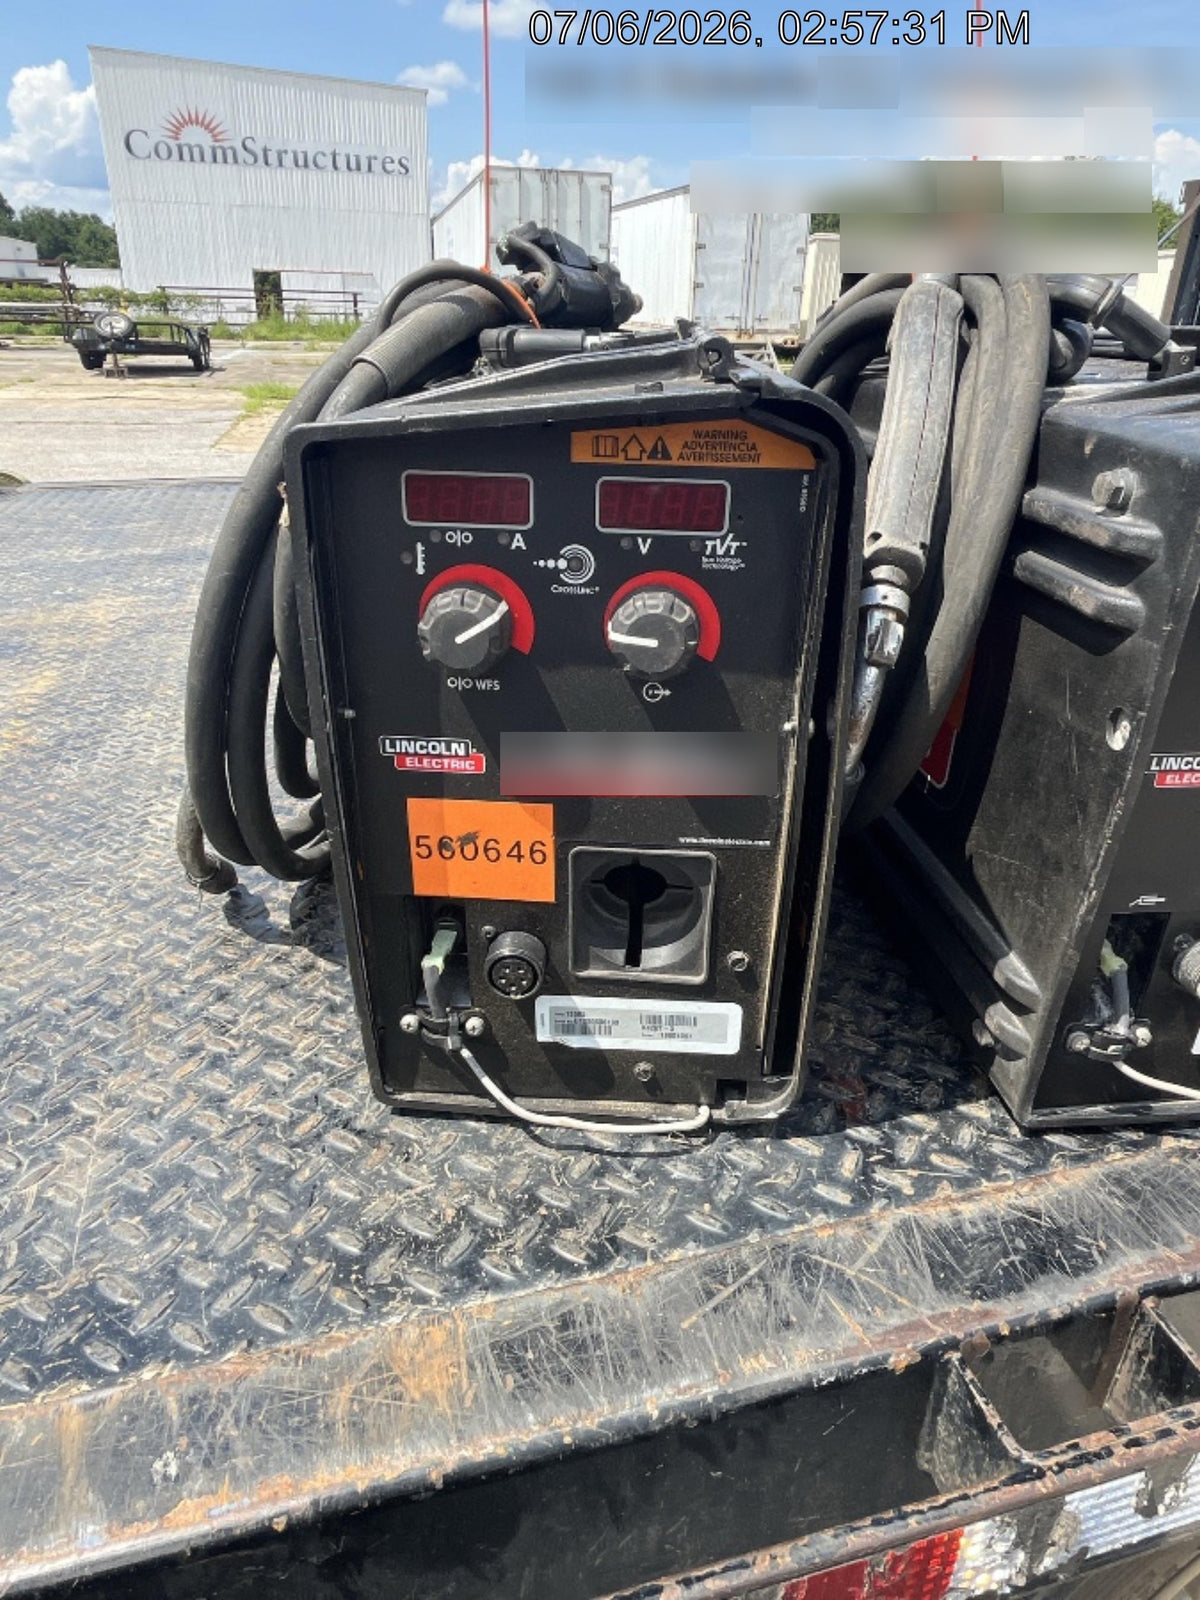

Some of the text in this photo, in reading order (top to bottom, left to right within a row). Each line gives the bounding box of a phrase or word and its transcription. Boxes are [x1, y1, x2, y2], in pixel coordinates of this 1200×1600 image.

[123, 128, 411, 176] CommStructures
[693, 429, 748, 441] WARNING
[682, 440, 758, 452] ADVERTENCIA
[677, 451, 762, 464] AVERTISSEMENT
[510, 533, 527, 550] A
[637, 536, 653, 555] V
[475, 679, 501, 691] WFS
[385, 739, 465, 756] LINCOLN
[405, 757, 476, 770] ELECTRIC
[1166, 773, 1200, 784] ELEC
[415, 835, 547, 865] 560646
